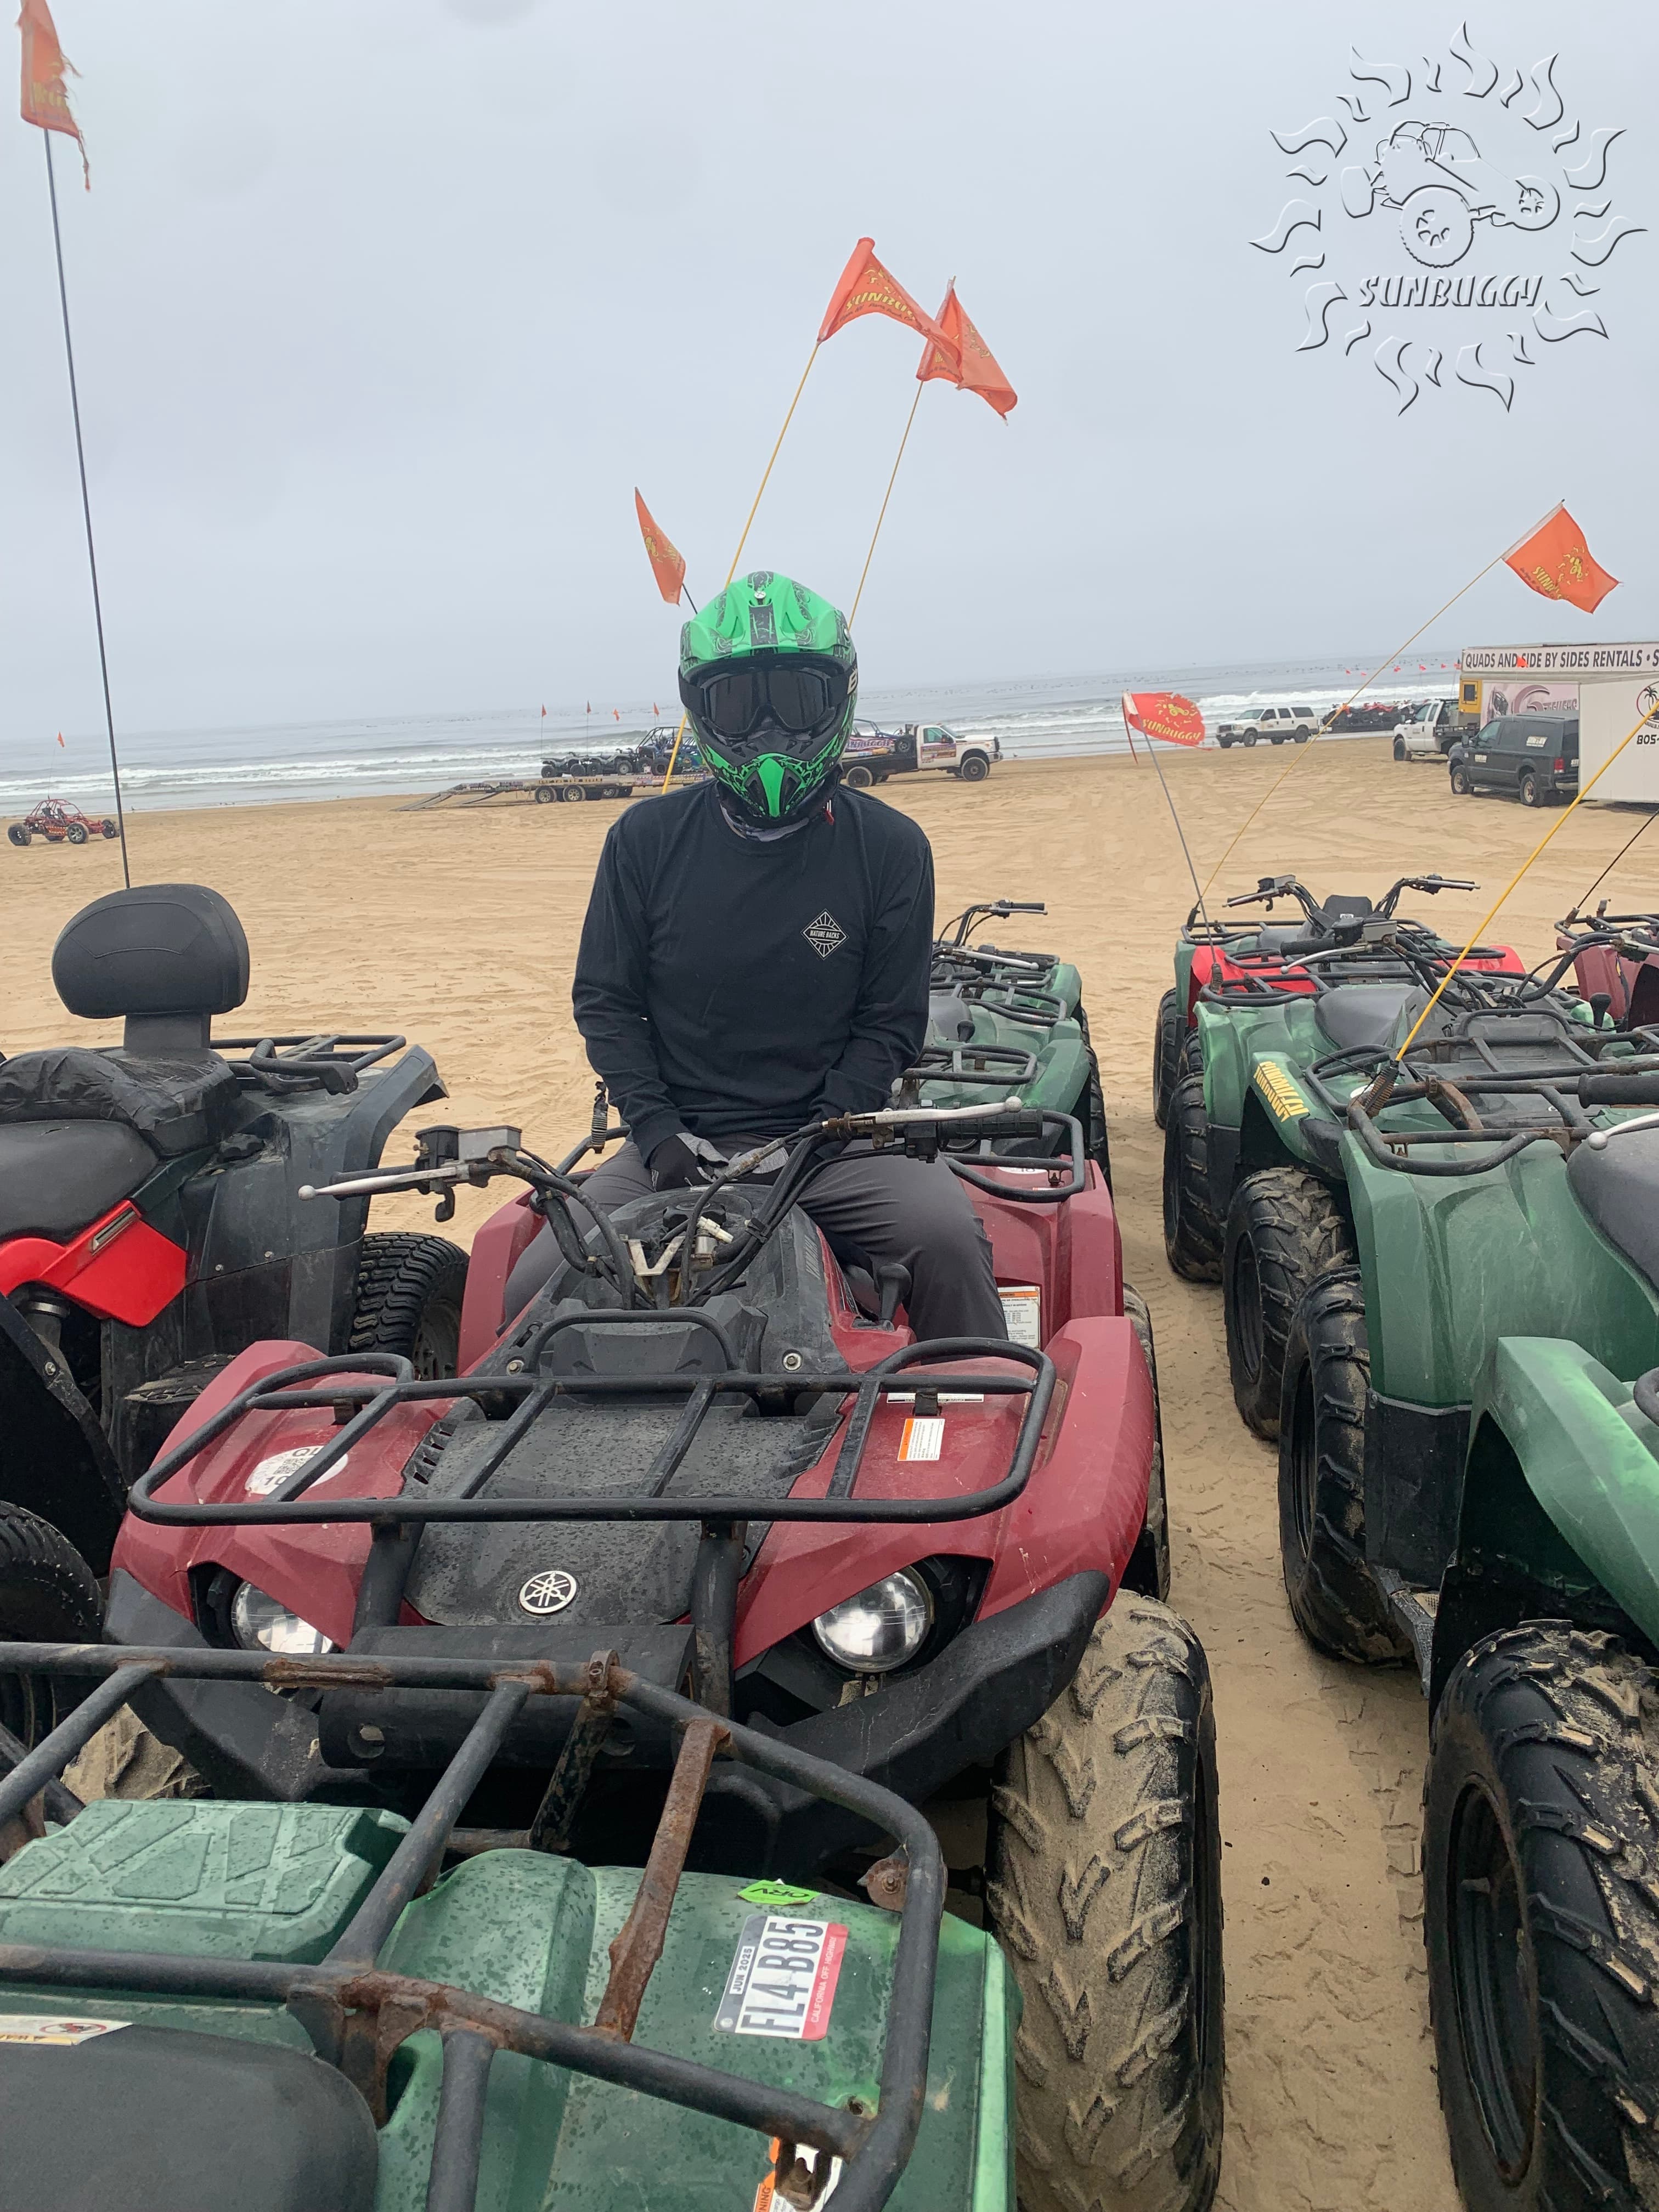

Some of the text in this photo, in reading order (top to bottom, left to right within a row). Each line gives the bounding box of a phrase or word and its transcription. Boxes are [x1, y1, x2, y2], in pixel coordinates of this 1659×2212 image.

[1465, 653, 1495, 669] QUADS
[1497, 653, 1518, 668] AND
[1545, 652, 1558, 668] BY
[1560, 651, 1589, 668] SIDES
[1593, 650, 1643, 667] RENTALS
[1142, 718, 1201, 741] SUNBUGGY
[809, 930, 825, 938] NATURE
[732, 1948, 753, 1993] JUN 2025
[811, 1936, 837, 2023] CALIFORNIA OFF HIGHWAY
